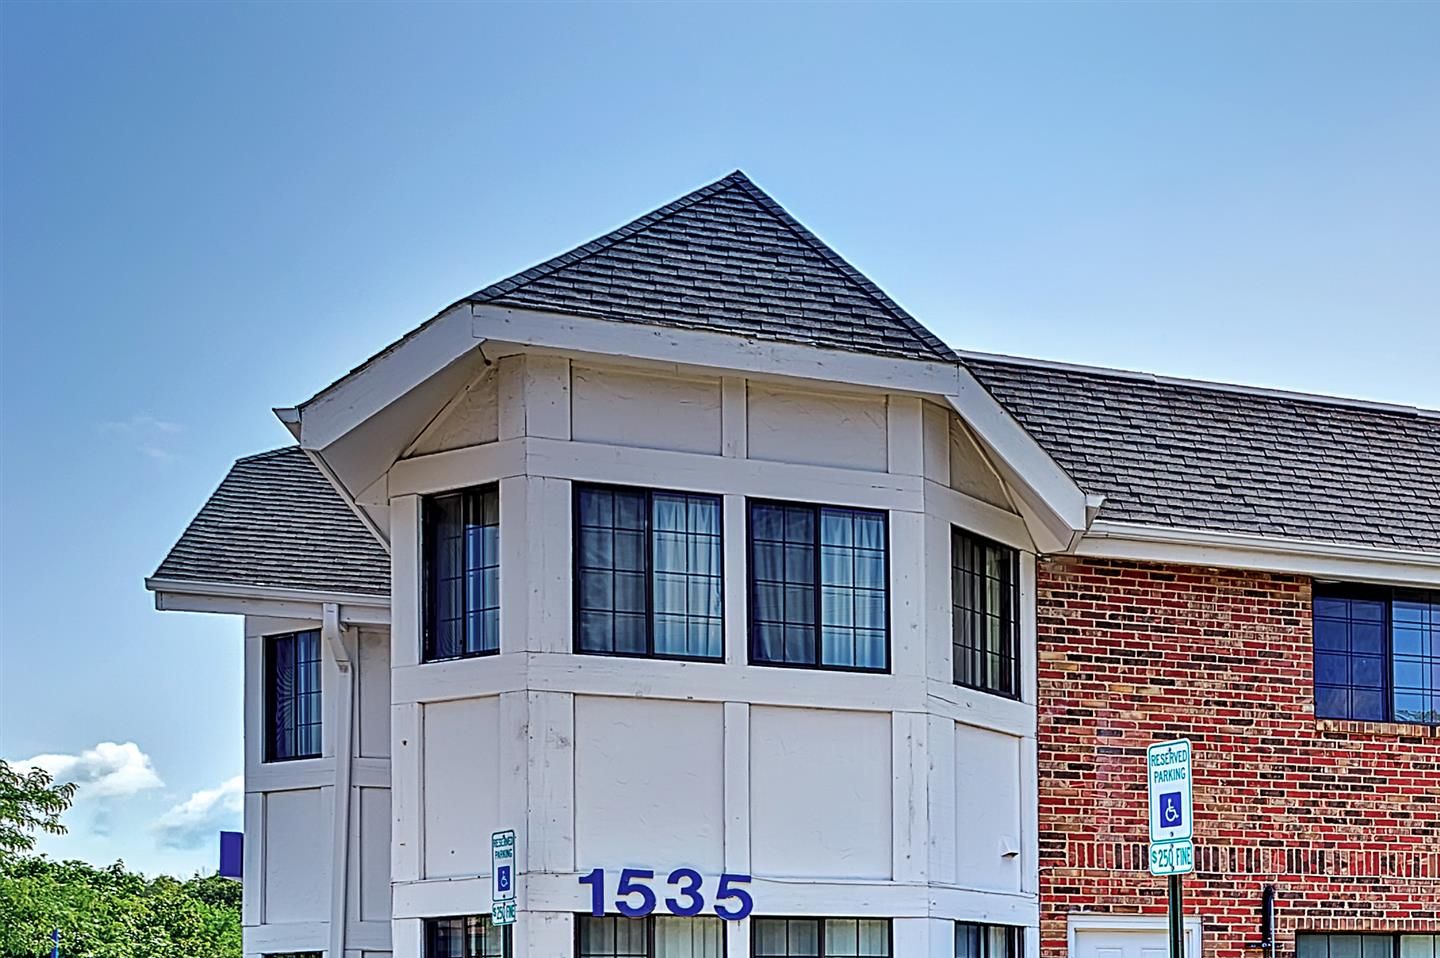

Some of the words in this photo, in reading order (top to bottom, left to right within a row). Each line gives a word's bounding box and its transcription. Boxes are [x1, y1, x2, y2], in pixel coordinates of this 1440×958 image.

[1150, 749, 1187, 767] RESERVED
[1154, 767, 1186, 783] PARKING
[1151, 850, 1174, 868] $250
[1176, 847, 1191, 866] FINE
[579, 868, 753, 921] 1535
